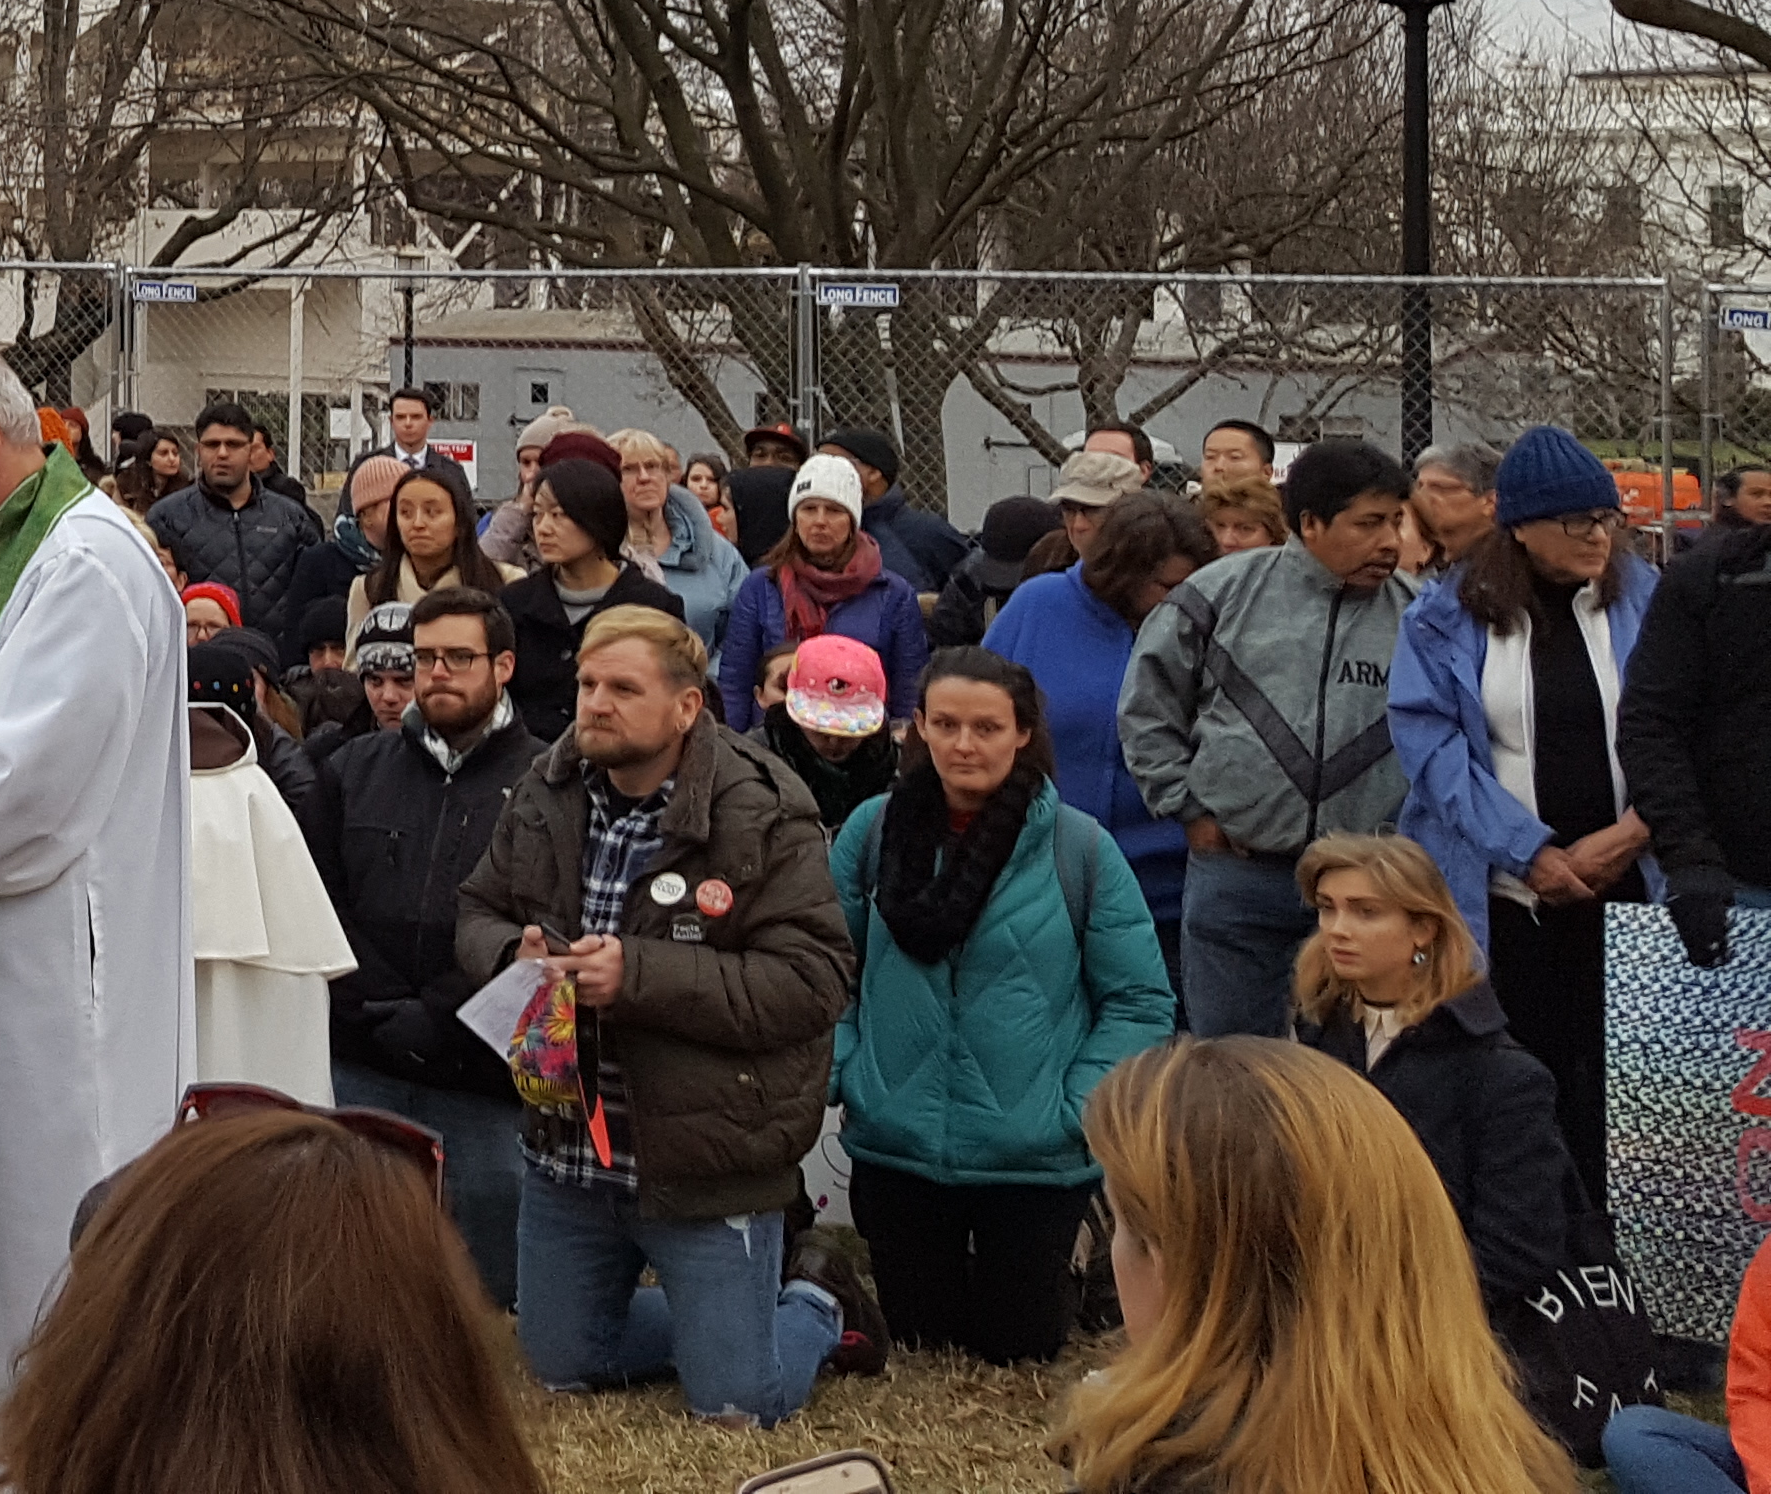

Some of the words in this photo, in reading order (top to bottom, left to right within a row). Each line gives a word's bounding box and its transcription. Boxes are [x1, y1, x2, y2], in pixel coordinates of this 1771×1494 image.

[137, 282, 161, 298] LONG
[163, 283, 192, 300] FENCE
[821, 286, 853, 303] LONG
[856, 286, 894, 304] FENCE
[1724, 308, 1764, 328] LONG
[1337, 659, 1391, 687] ARM
